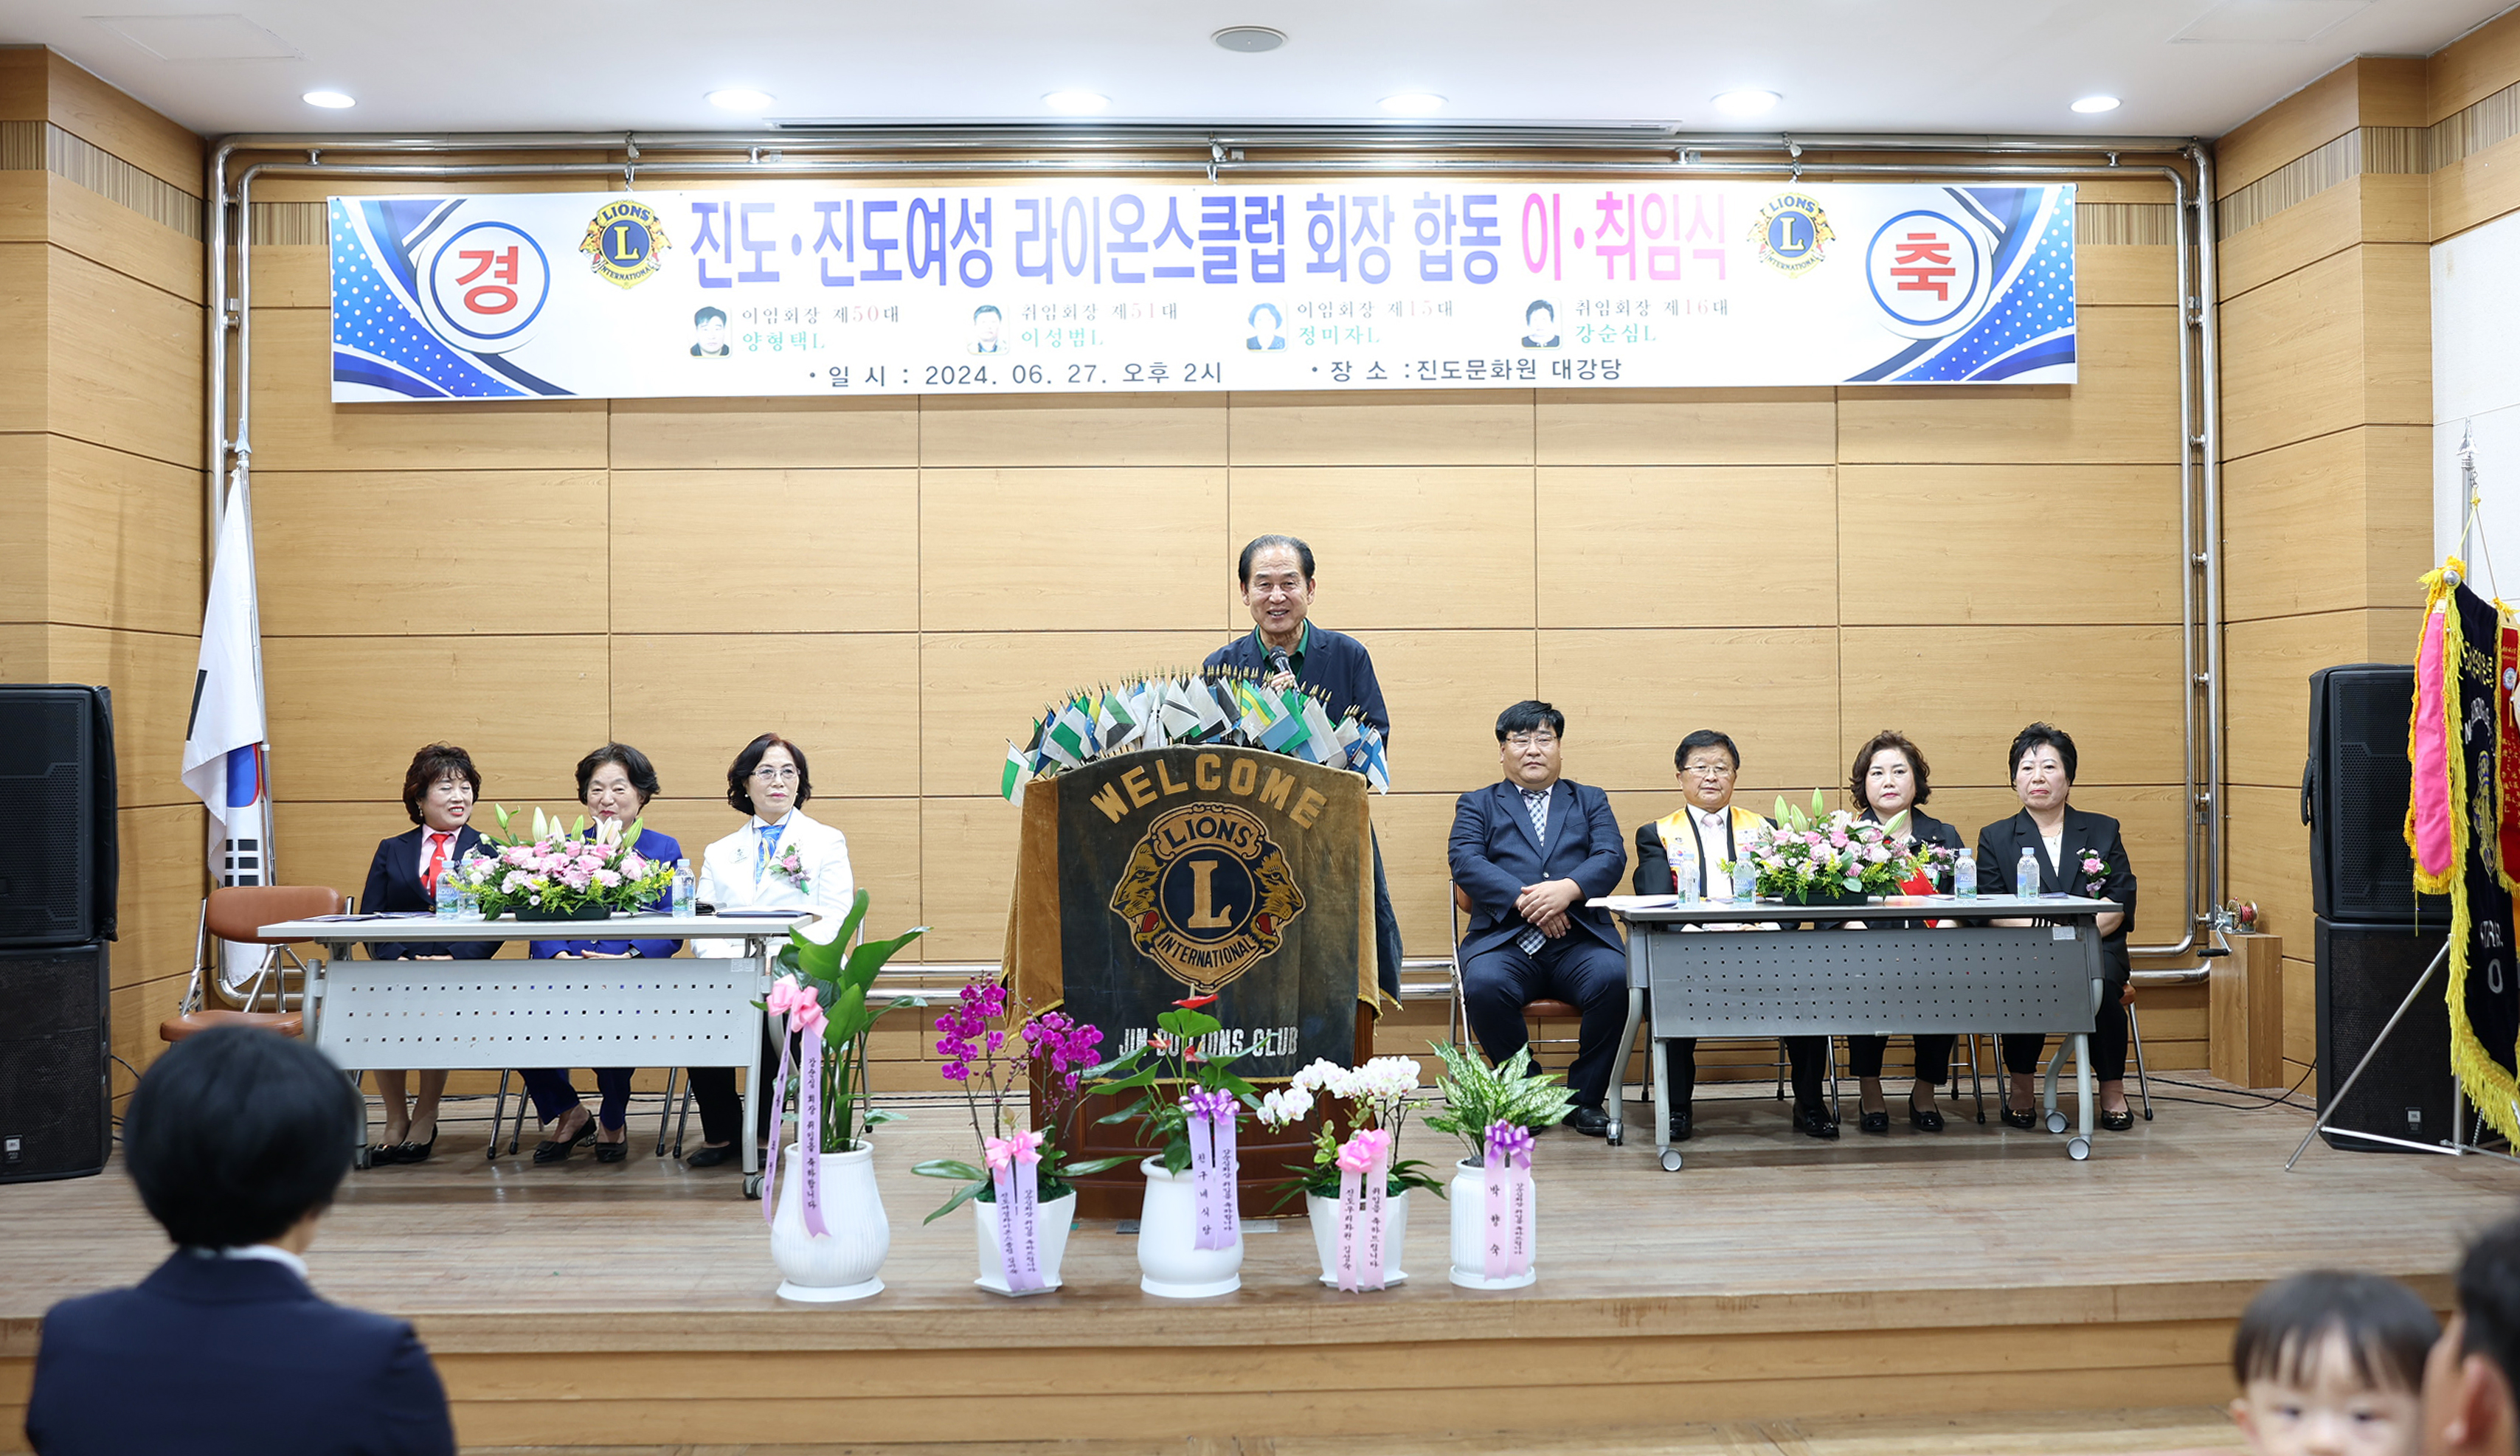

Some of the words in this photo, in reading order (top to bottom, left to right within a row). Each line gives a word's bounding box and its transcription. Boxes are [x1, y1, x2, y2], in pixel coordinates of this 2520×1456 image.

[602, 204, 650, 221] LIONS
[1769, 195, 1815, 213] LIONS
[614, 226, 640, 260] L
[1015, 194, 1285, 285] 라이온스클럽
[1306, 193, 1395, 284] 회장
[1413, 192, 1501, 285] 합동
[1522, 191, 1725, 281] 이·취임식
[1779, 217, 1805, 250] L
[1890, 233, 1956, 302] 축
[456, 246, 518, 314] 경
[742, 307, 820, 325] 이임회장
[834, 305, 899, 324] 제50대
[1022, 303, 1098, 321] 취임회장
[1112, 302, 1177, 320] 제51대
[1298, 301, 1374, 319] 이임회장
[1388, 300, 1452, 317] 제15대
[1576, 299, 1651, 317] 취임회장
[1664, 299, 1728, 316] 제16대
[742, 330, 825, 352] 양형택L
[1021, 327, 1104, 348] 이성범L
[1298, 325, 1381, 346] 정미자L
[1575, 323, 1657, 344] 강순심L
[925, 365, 997, 385] 2024.
[1013, 364, 1051, 384] 06.
[1068, 364, 1106, 384] 27.
[1123, 362, 1169, 384] 오후
[1184, 362, 1221, 384] 2시
[1552, 358, 1621, 380] 대강당
[1090, 753, 1327, 829] WELCOME
[1163, 817, 1254, 849] LIONS
[1188, 860, 1232, 929] L
[1157, 934, 1257, 968] INTERNATIONAL
[1253, 1026, 1299, 1057] CLUB
[808, 1095, 815, 1114] 회장
[1371, 1187, 1380, 1213] 취임을
[1370, 1216, 1380, 1267] 축하드립니다
